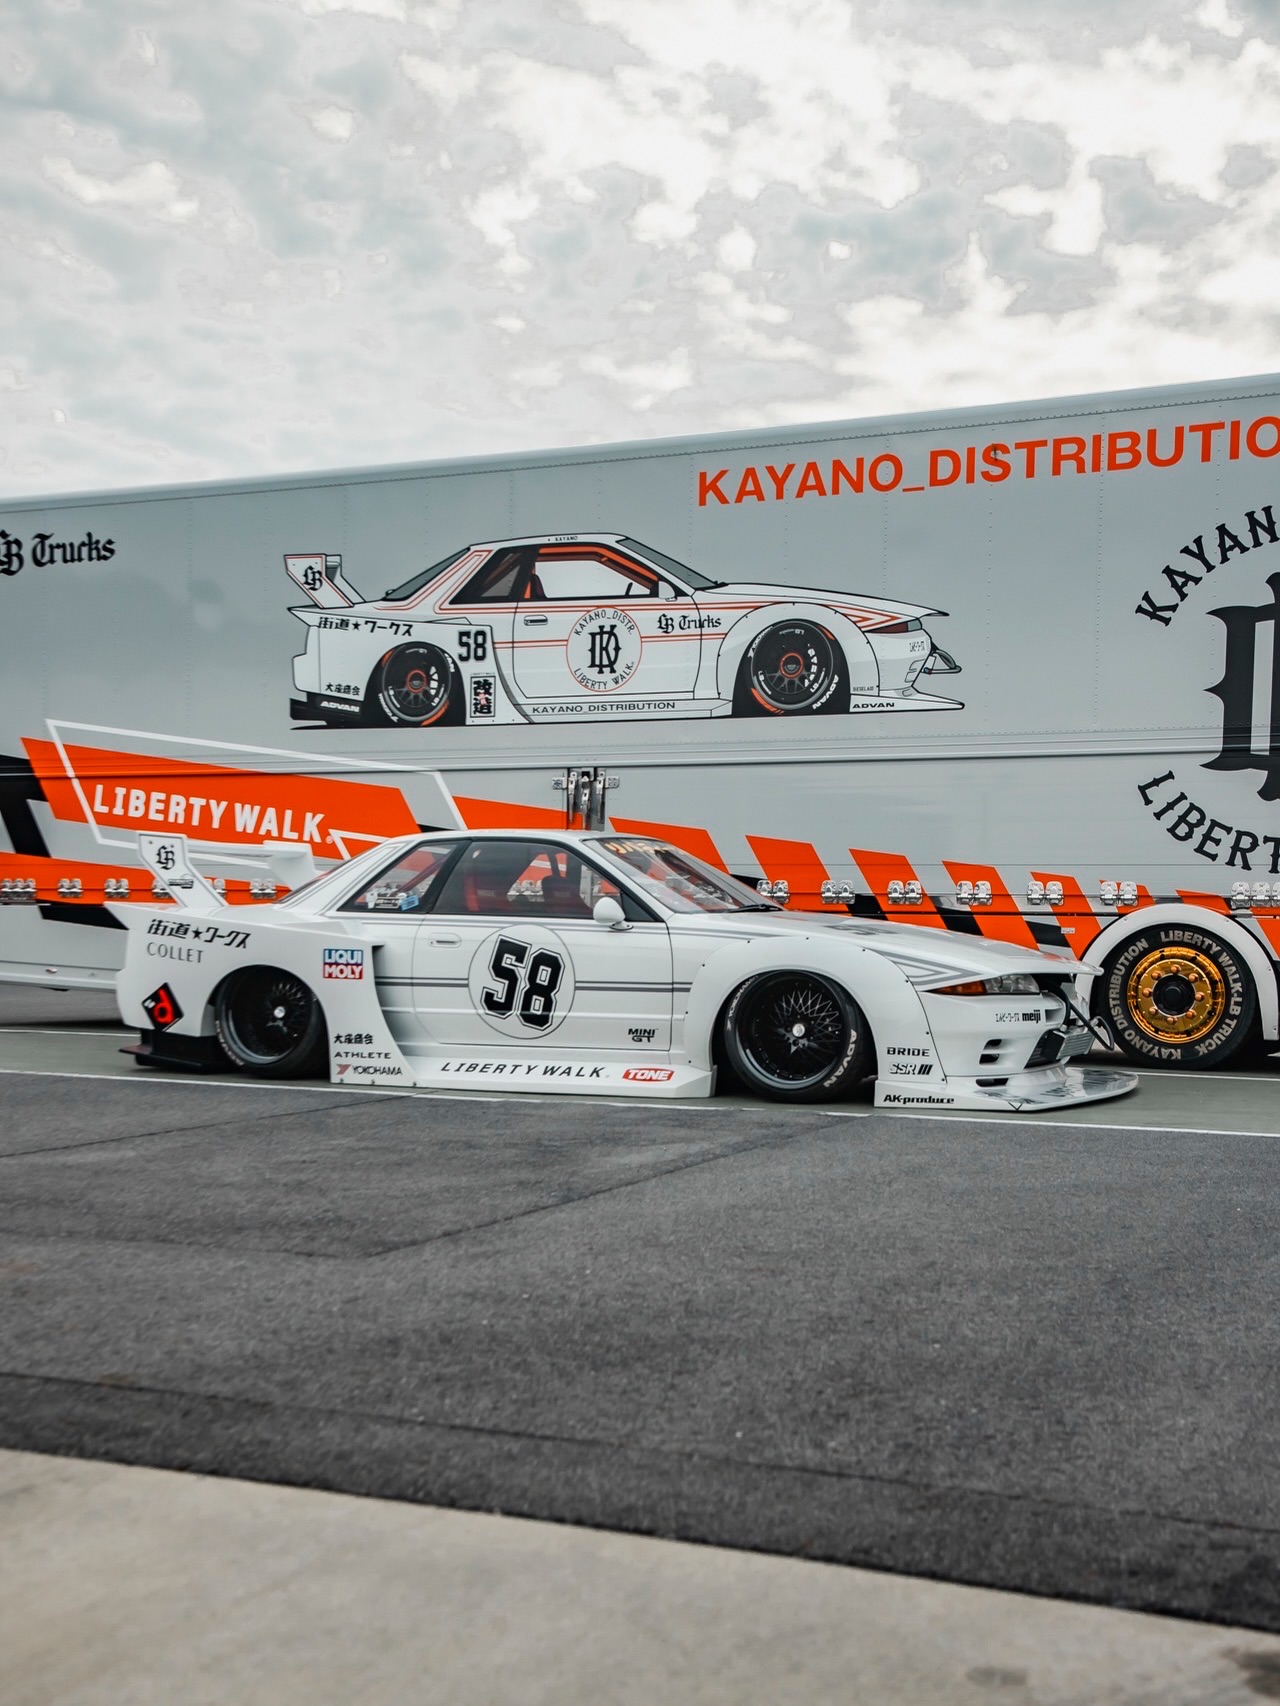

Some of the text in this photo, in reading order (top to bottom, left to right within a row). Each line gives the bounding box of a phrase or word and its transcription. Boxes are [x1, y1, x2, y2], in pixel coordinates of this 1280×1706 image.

[32, 531, 116, 567] Trucks
[678, 613, 722, 631] Trucks
[458, 630, 487, 662] 58
[574, 667, 608, 690] LIBERTY
[320, 700, 360, 713] ADVAN
[93, 784, 326, 843] LIBERTY WALK
[147, 941, 203, 964] COLLET
[325, 950, 363, 964] LIQUI
[324, 964, 362, 978] MOLY
[480, 934, 566, 1031] 58
[1108, 938, 1182, 1060] KAYANO DISTRIBUTION
[1160, 930, 1222, 955] LIBERTY
[1194, 1019, 1237, 1056] TRUCK
[1022, 1009, 1041, 1024] meiji
[628, 1028, 656, 1036] MINI
[632, 1035, 655, 1043] GT
[334, 1051, 392, 1060] ATHLETE
[823, 1029, 858, 1088] ADVAN
[886, 1046, 931, 1057] BRIDE
[353, 1065, 403, 1076] YOKOHAMA
[440, 1062, 606, 1079] LIBERTY WALK
[627, 1069, 671, 1081] TONE
[889, 1062, 917, 1076] SSR
